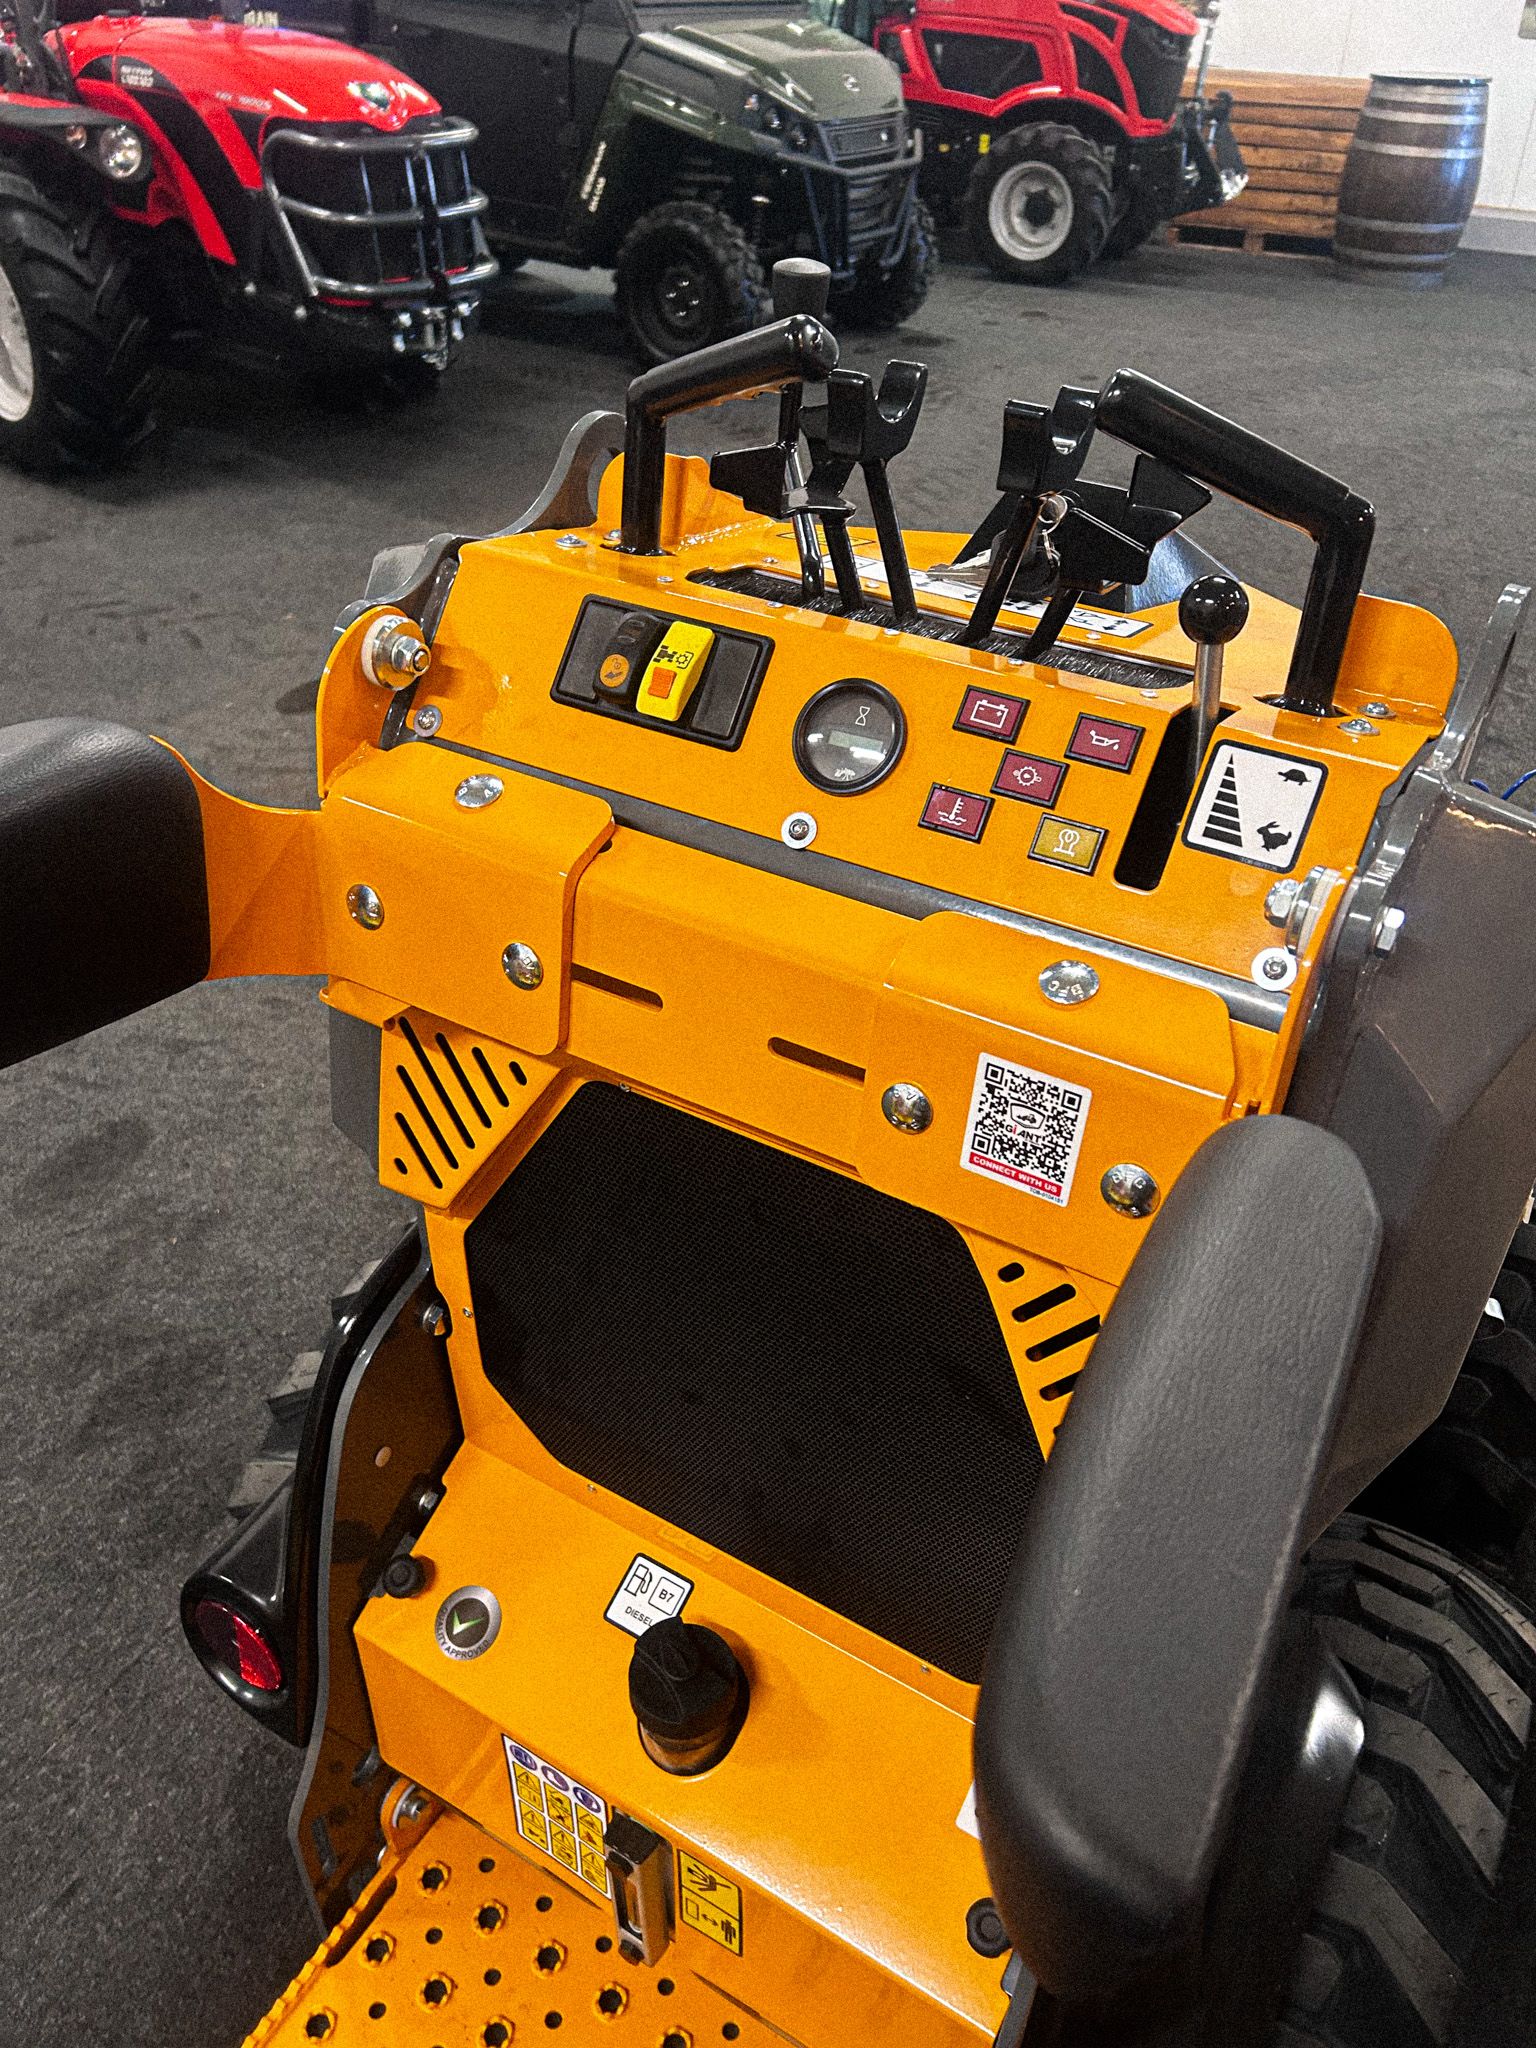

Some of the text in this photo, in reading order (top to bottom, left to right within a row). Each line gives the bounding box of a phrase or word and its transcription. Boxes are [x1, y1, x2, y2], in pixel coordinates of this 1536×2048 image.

[973, 1156, 1057, 1193] CONNECT WITH US
[658, 1588, 675, 1602] B7
[624, 1606, 654, 1627] DIESEL
[437, 1607, 490, 1659] QUALITY APPROVED
